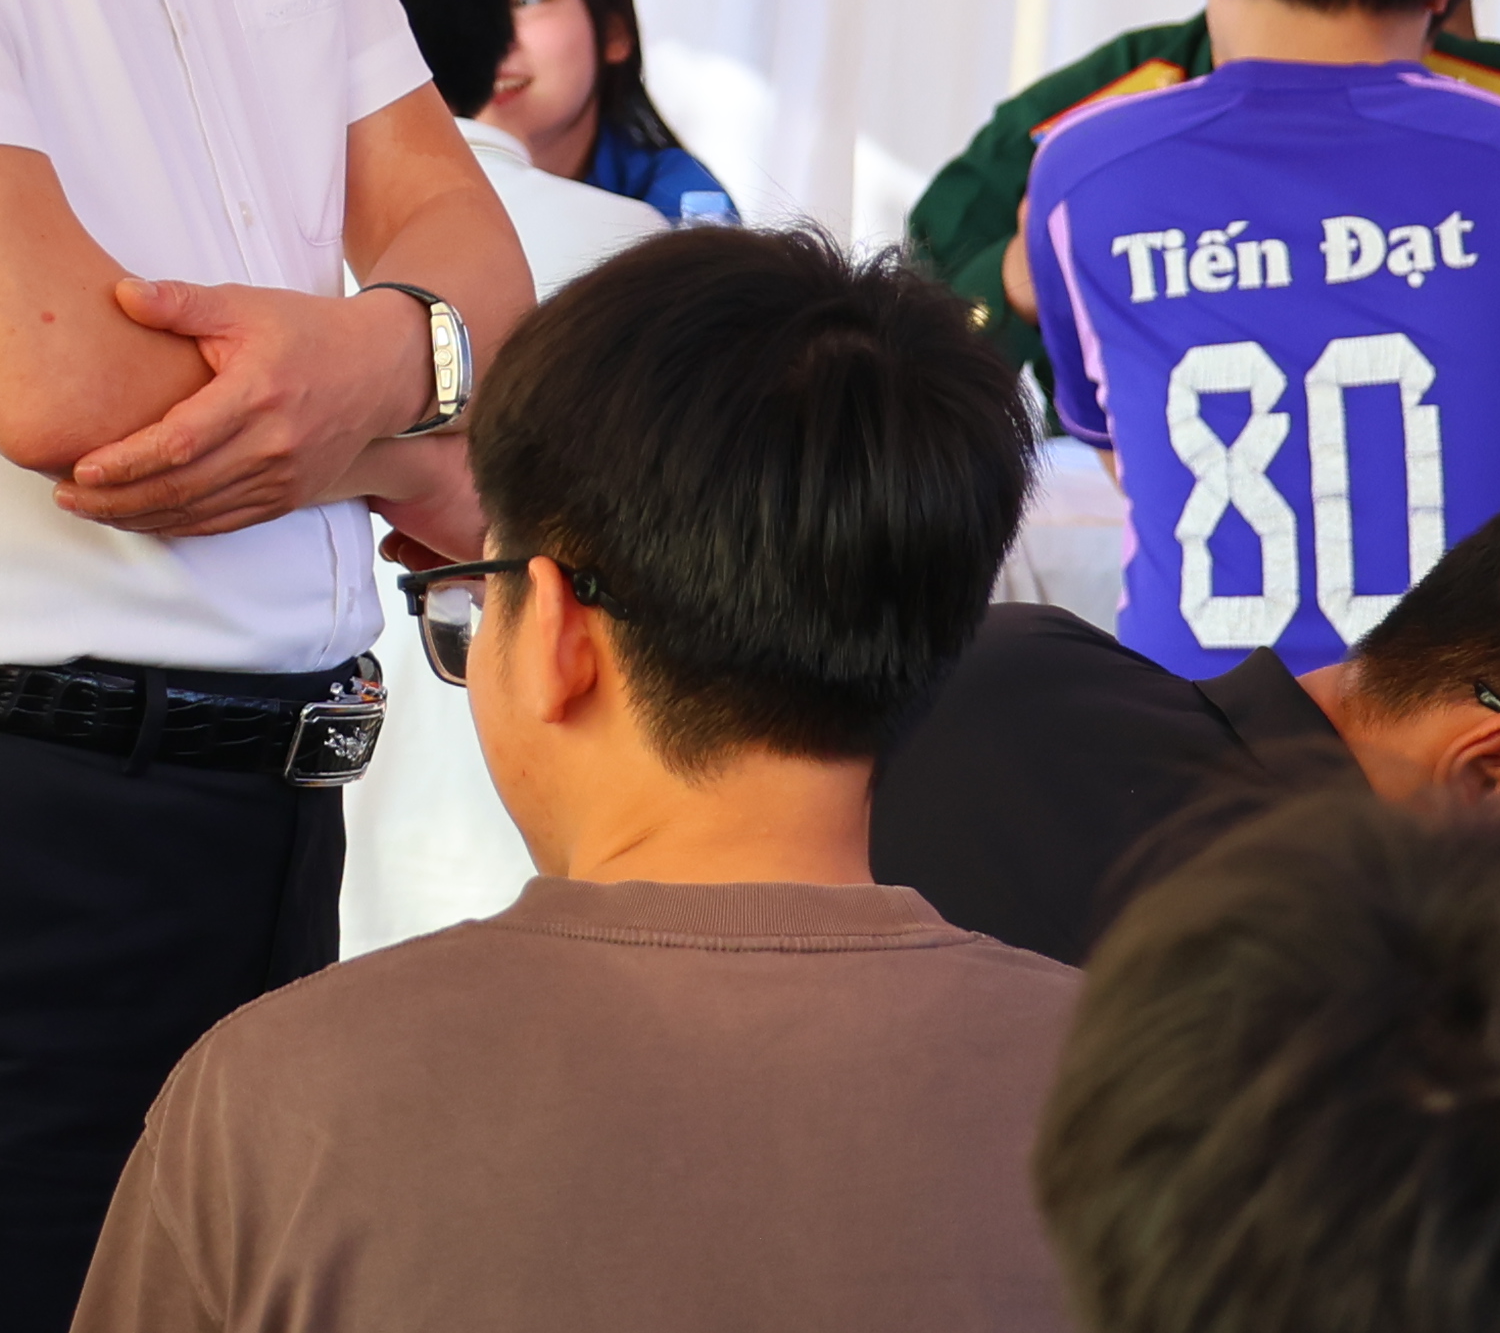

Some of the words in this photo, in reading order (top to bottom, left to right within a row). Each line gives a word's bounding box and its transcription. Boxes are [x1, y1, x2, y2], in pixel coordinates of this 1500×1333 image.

[1111, 220, 1292, 304] Tiến
[1319, 211, 1478, 289] Đạt
[1165, 332, 1446, 650] 80
